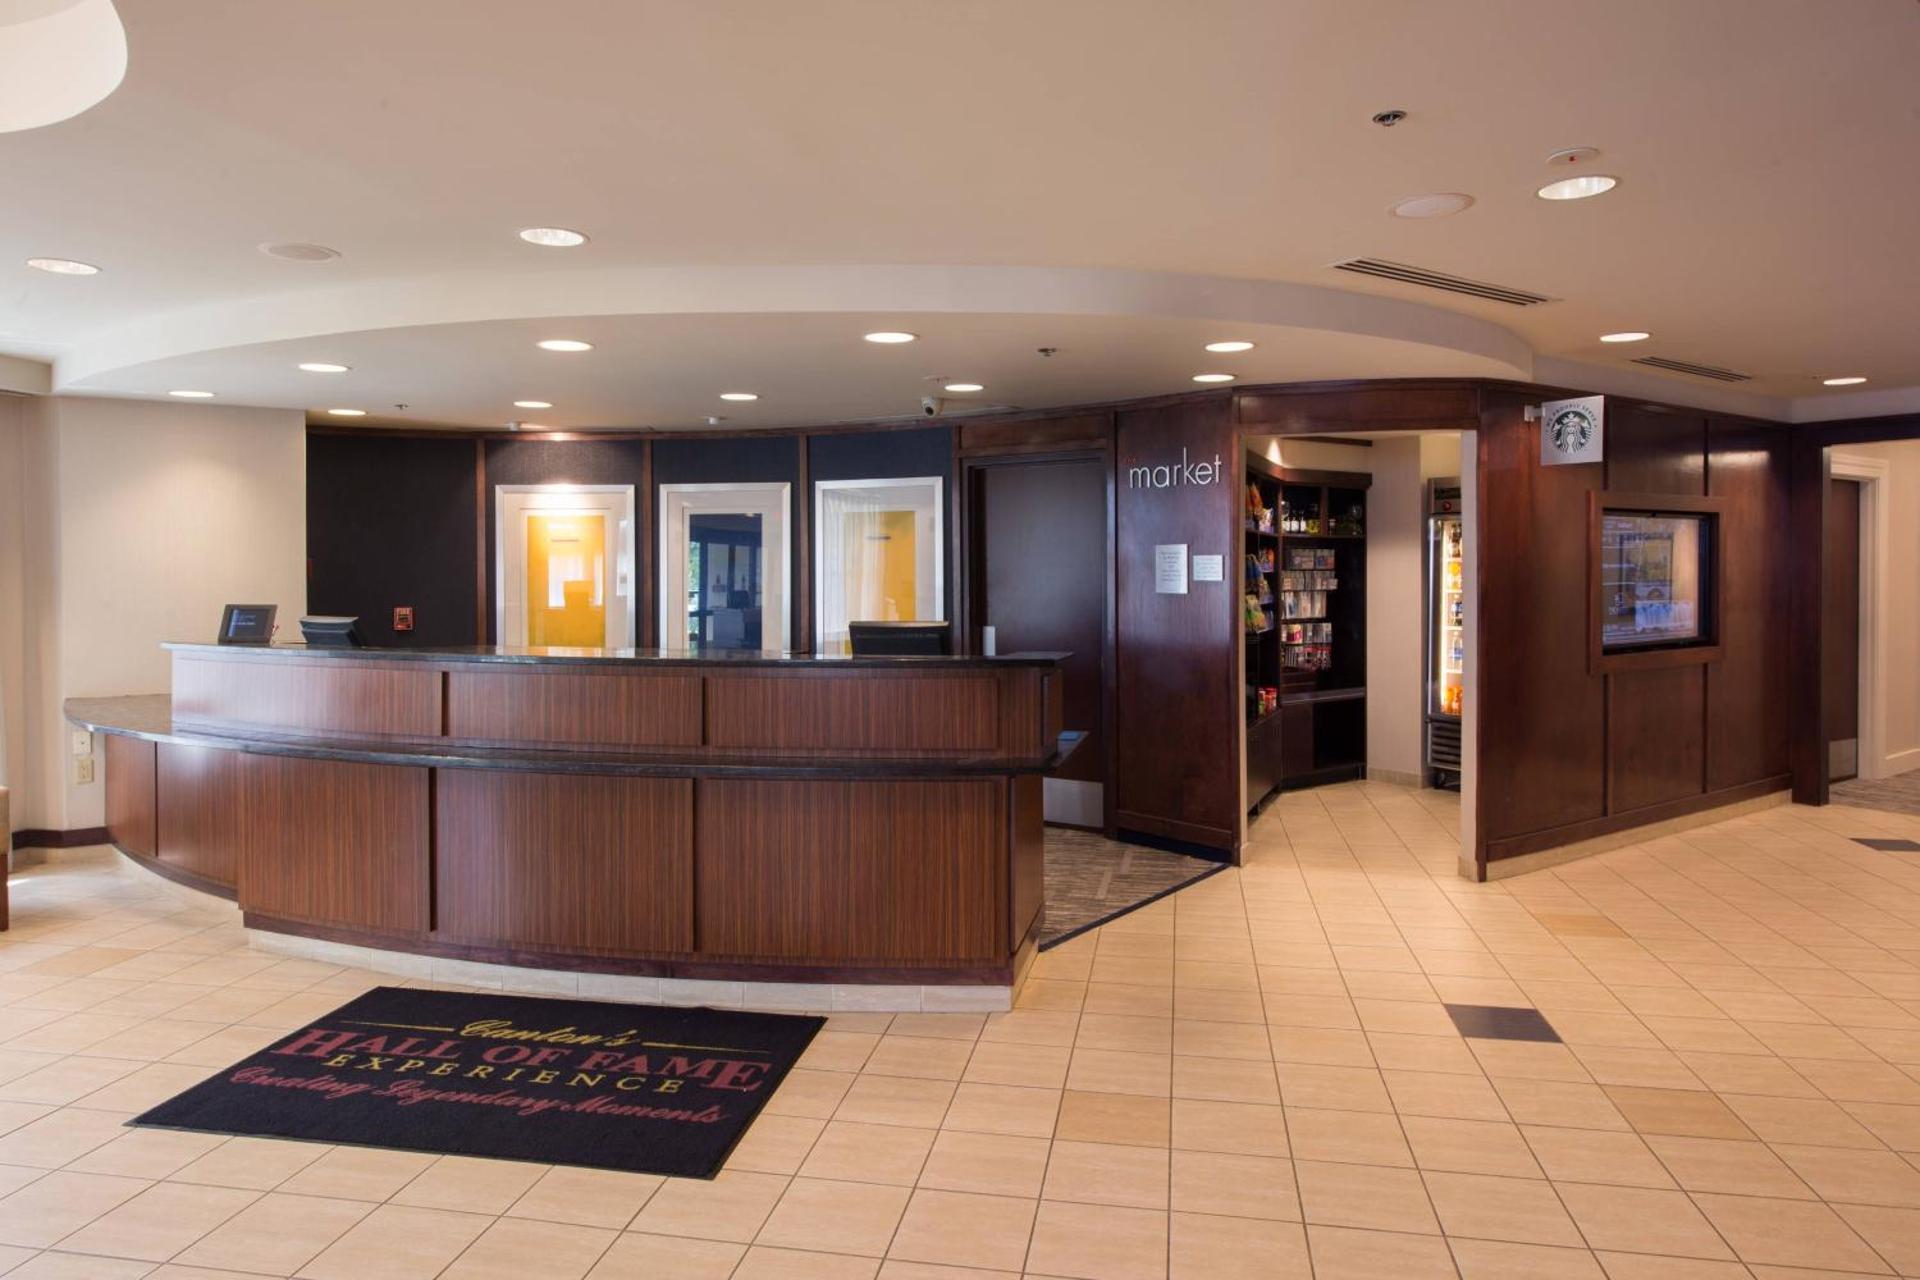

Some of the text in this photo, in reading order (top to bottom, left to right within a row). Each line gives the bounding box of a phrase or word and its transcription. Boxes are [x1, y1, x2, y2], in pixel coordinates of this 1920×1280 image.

[1129, 446, 1222, 488] market
[459, 1020, 640, 1047] Canton's
[270, 1028, 772, 1092] HALL OF FAME
[322, 1054, 685, 1093] EXPERIENCE
[230, 1066, 728, 1124] Creating Legendary Moments
